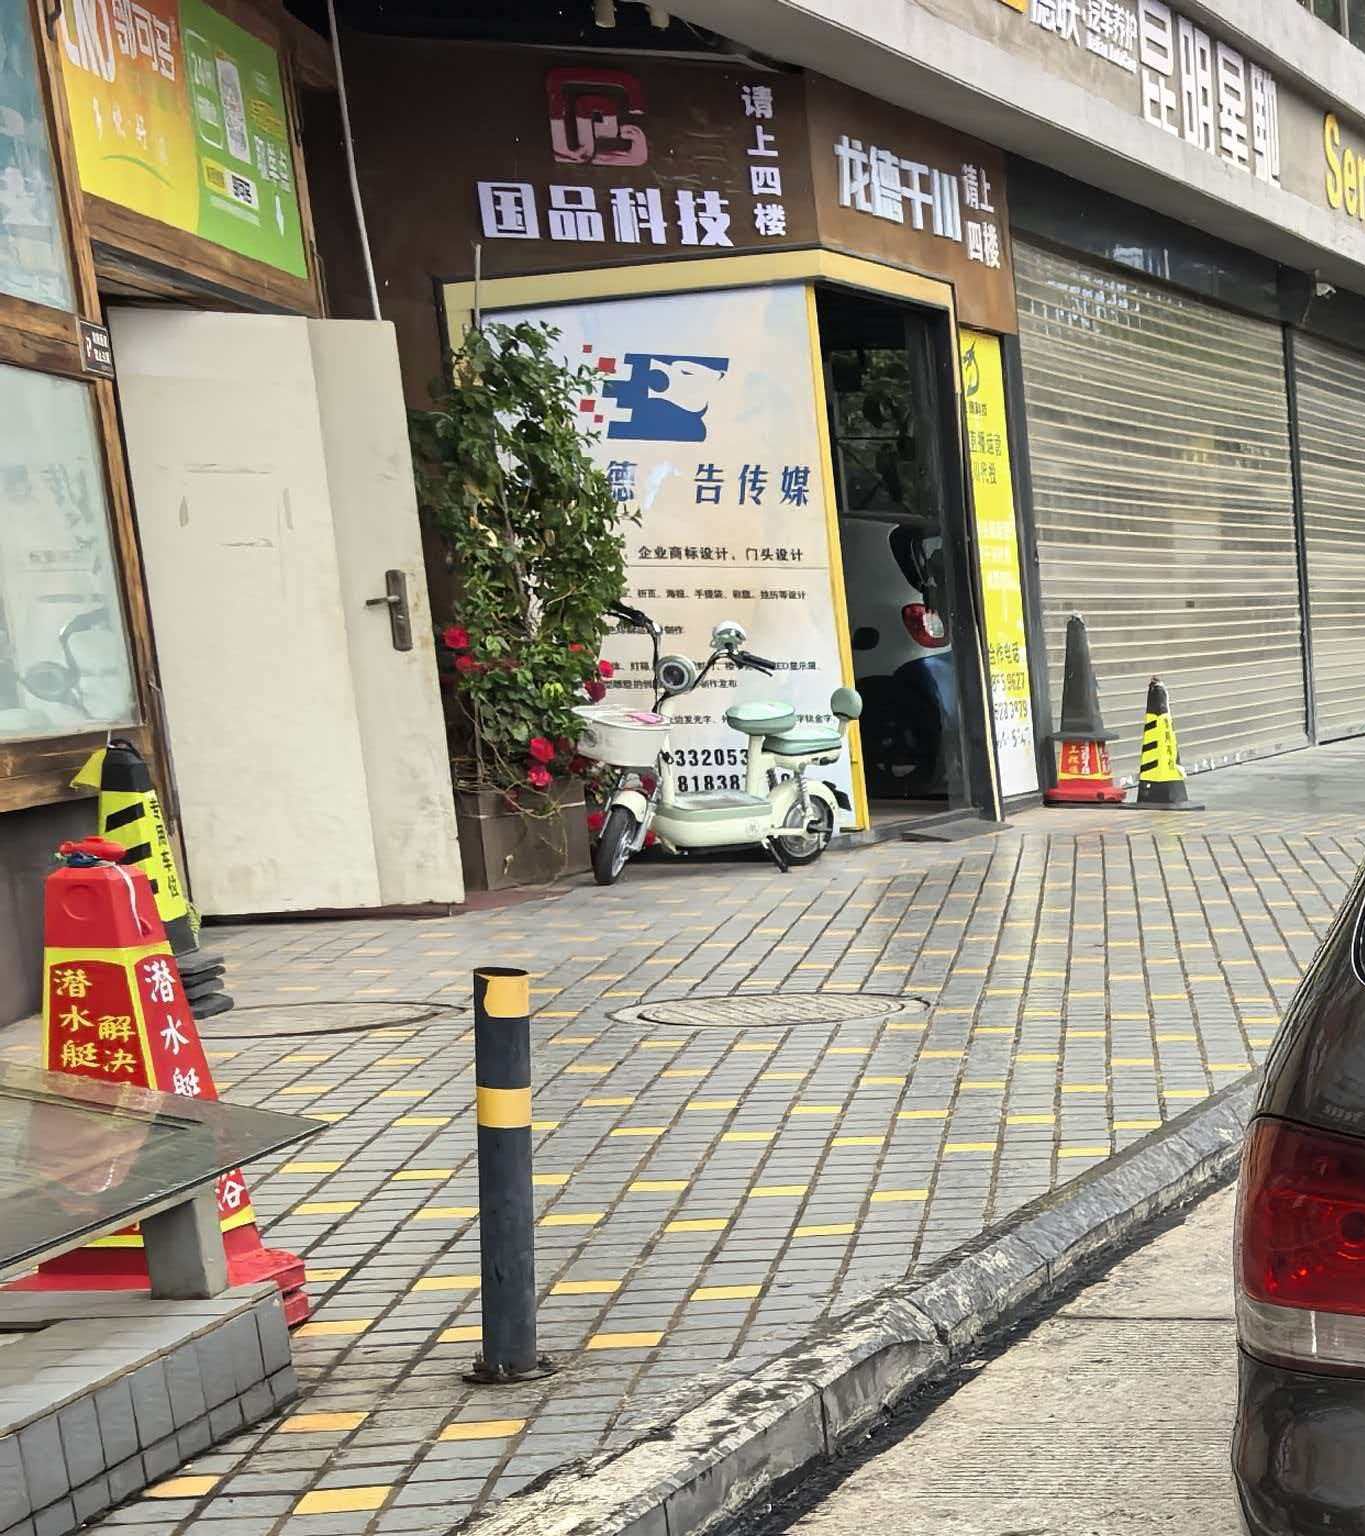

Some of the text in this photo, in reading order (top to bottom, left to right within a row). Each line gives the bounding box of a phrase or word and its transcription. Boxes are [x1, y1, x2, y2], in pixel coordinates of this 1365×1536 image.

[741, 84, 787, 237] 请上四楼
[477, 181, 734, 248] 国品科技
[965, 220, 1001, 270] 四楼
[607, 460, 811, 507] 德告传媒
[677, 775, 746, 792] 81838
[54, 969, 99, 1069] 潜水艇
[143, 959, 201, 1098] 潜水艇
